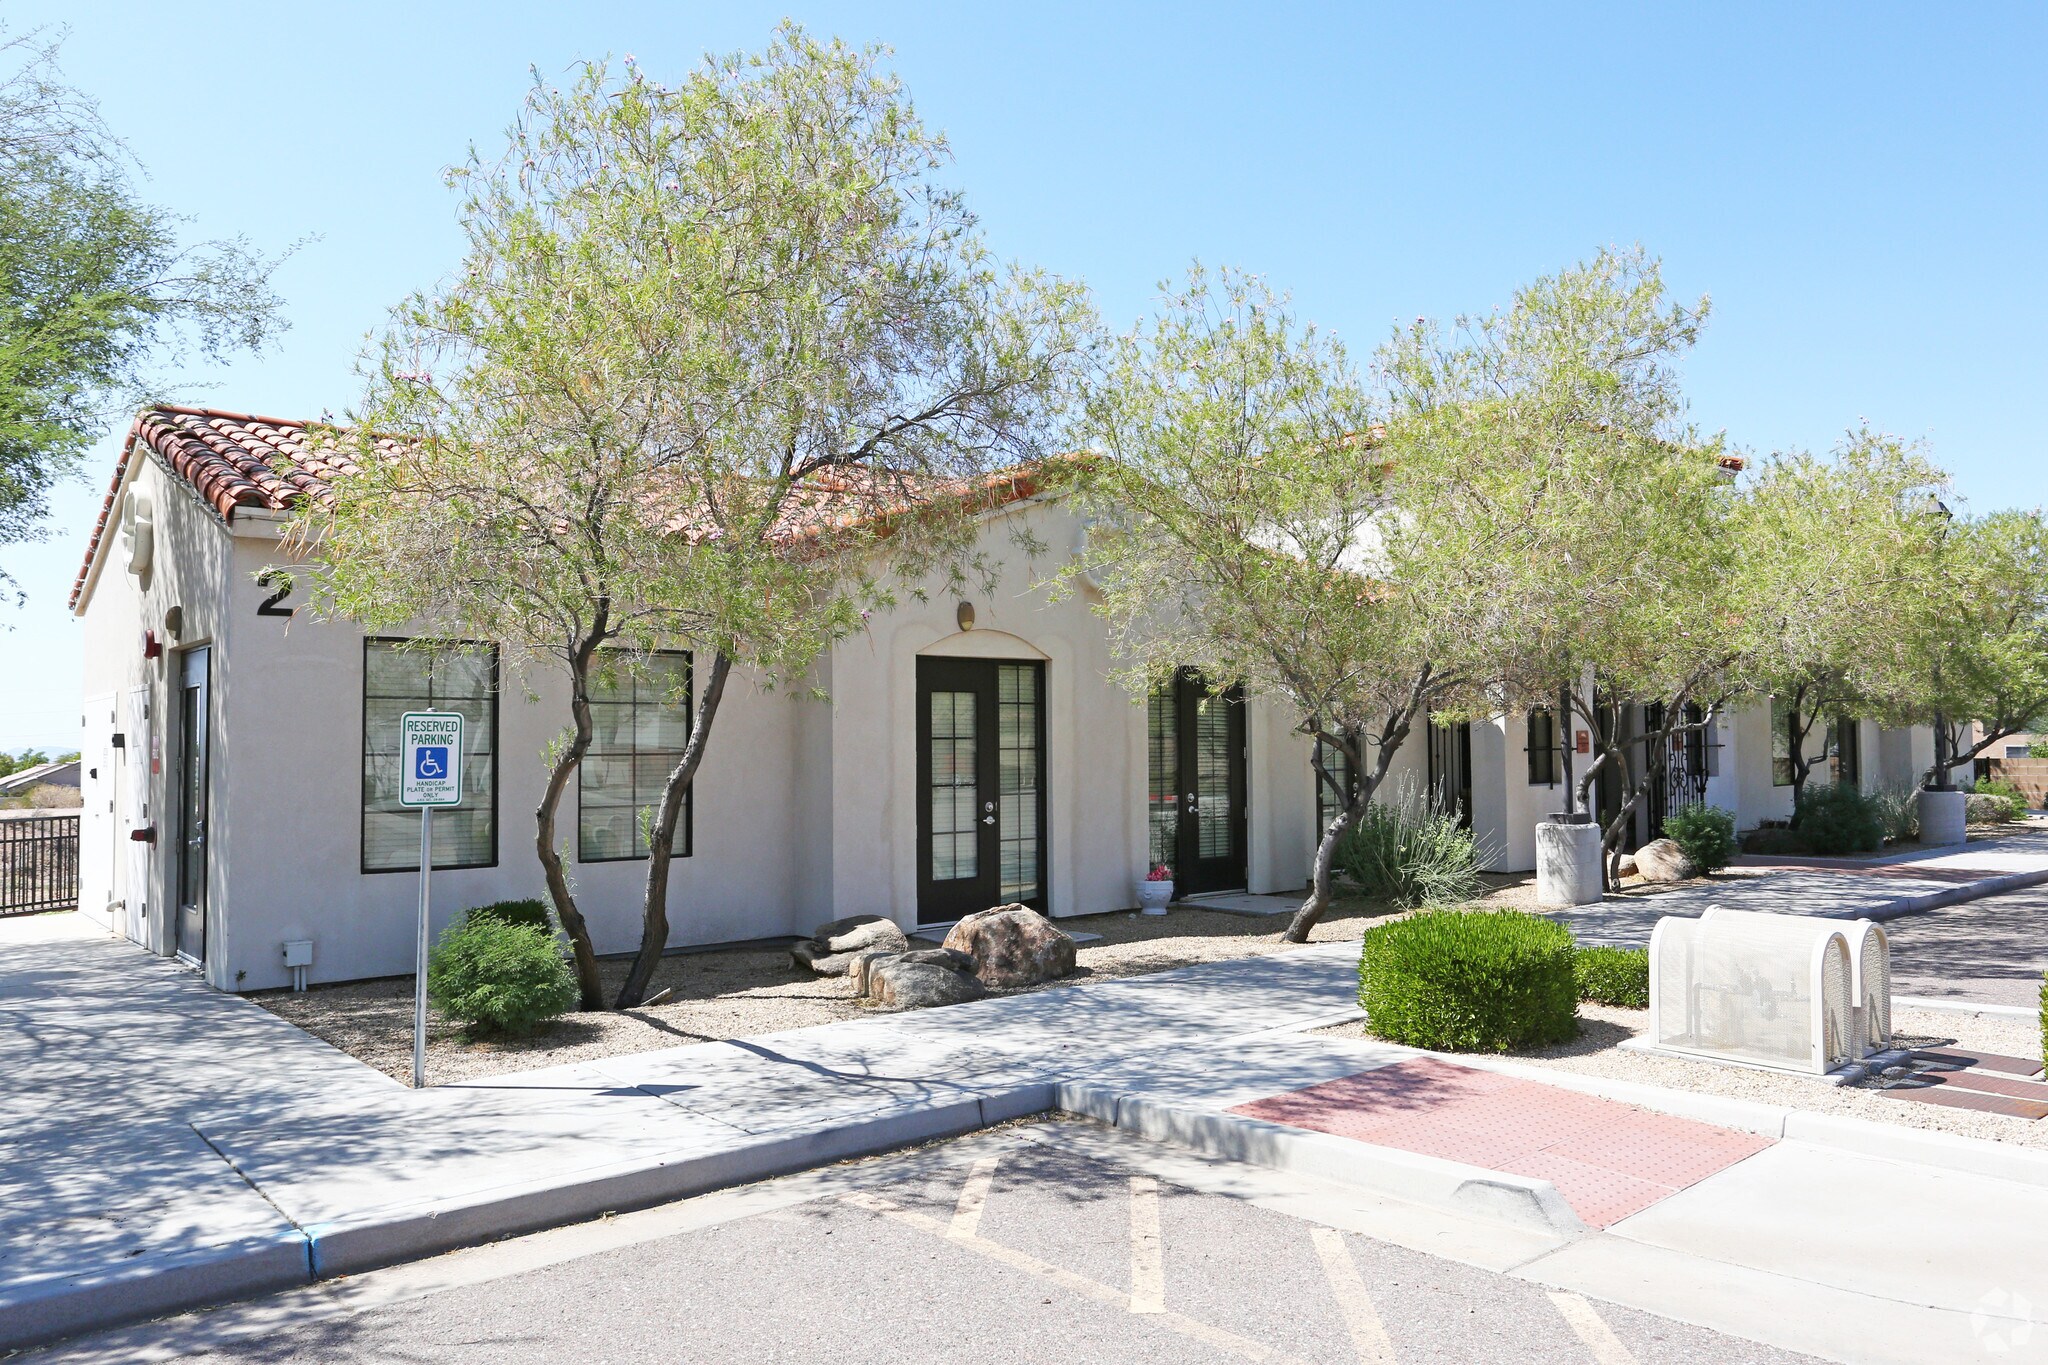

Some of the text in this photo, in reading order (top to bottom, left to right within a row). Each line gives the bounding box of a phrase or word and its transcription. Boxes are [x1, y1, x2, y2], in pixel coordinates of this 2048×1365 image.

[257, 569, 293, 616] 2
[407, 721, 458, 732] RESERVED
[411, 734, 454, 745] PARKING
